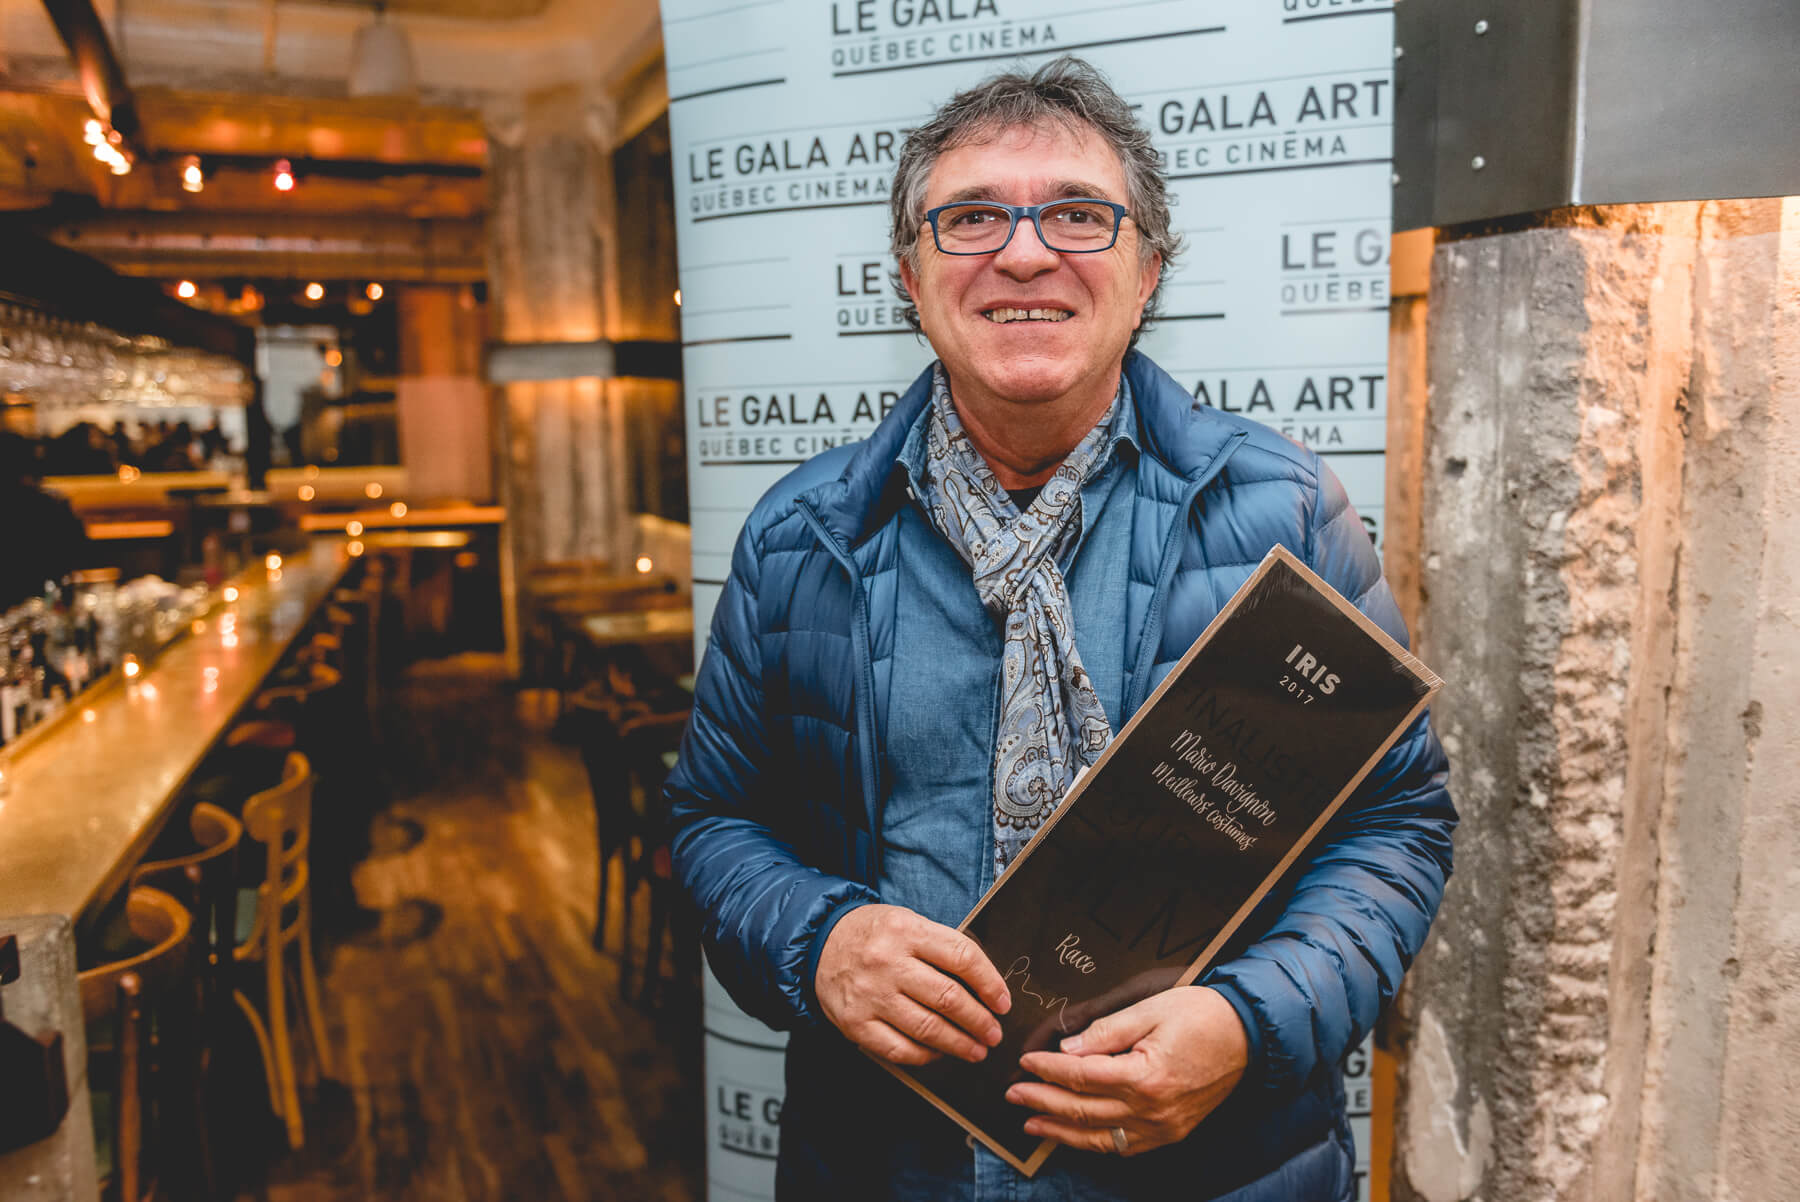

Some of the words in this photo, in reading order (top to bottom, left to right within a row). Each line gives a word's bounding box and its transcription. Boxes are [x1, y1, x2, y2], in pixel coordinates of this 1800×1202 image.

[832, 0, 877, 36] LE
[1159, 91, 1277, 135] GALA
[1297, 80, 1389, 124] ART
[689, 149, 724, 183] LE
[735, 136, 829, 175] GALA
[1281, 231, 1337, 270] LE
[838, 262, 882, 296] LE
[1281, 273, 1385, 304] QUÉBE
[698, 397, 730, 428] LE
[741, 392, 835, 426] GALA
[1193, 378, 1275, 413] ALA
[1293, 375, 1384, 412] ART
[1285, 644, 1341, 695] IRIS
[1280, 675, 1315, 704] 2017
[1170, 729, 1217, 775] Mario
[1212, 762, 1277, 826] Davignon
[1152, 761, 1215, 814] Meilleurs
[1206, 810, 1259, 851] costumes
[1055, 932, 1097, 974] Race
[718, 1085, 752, 1121] LE
